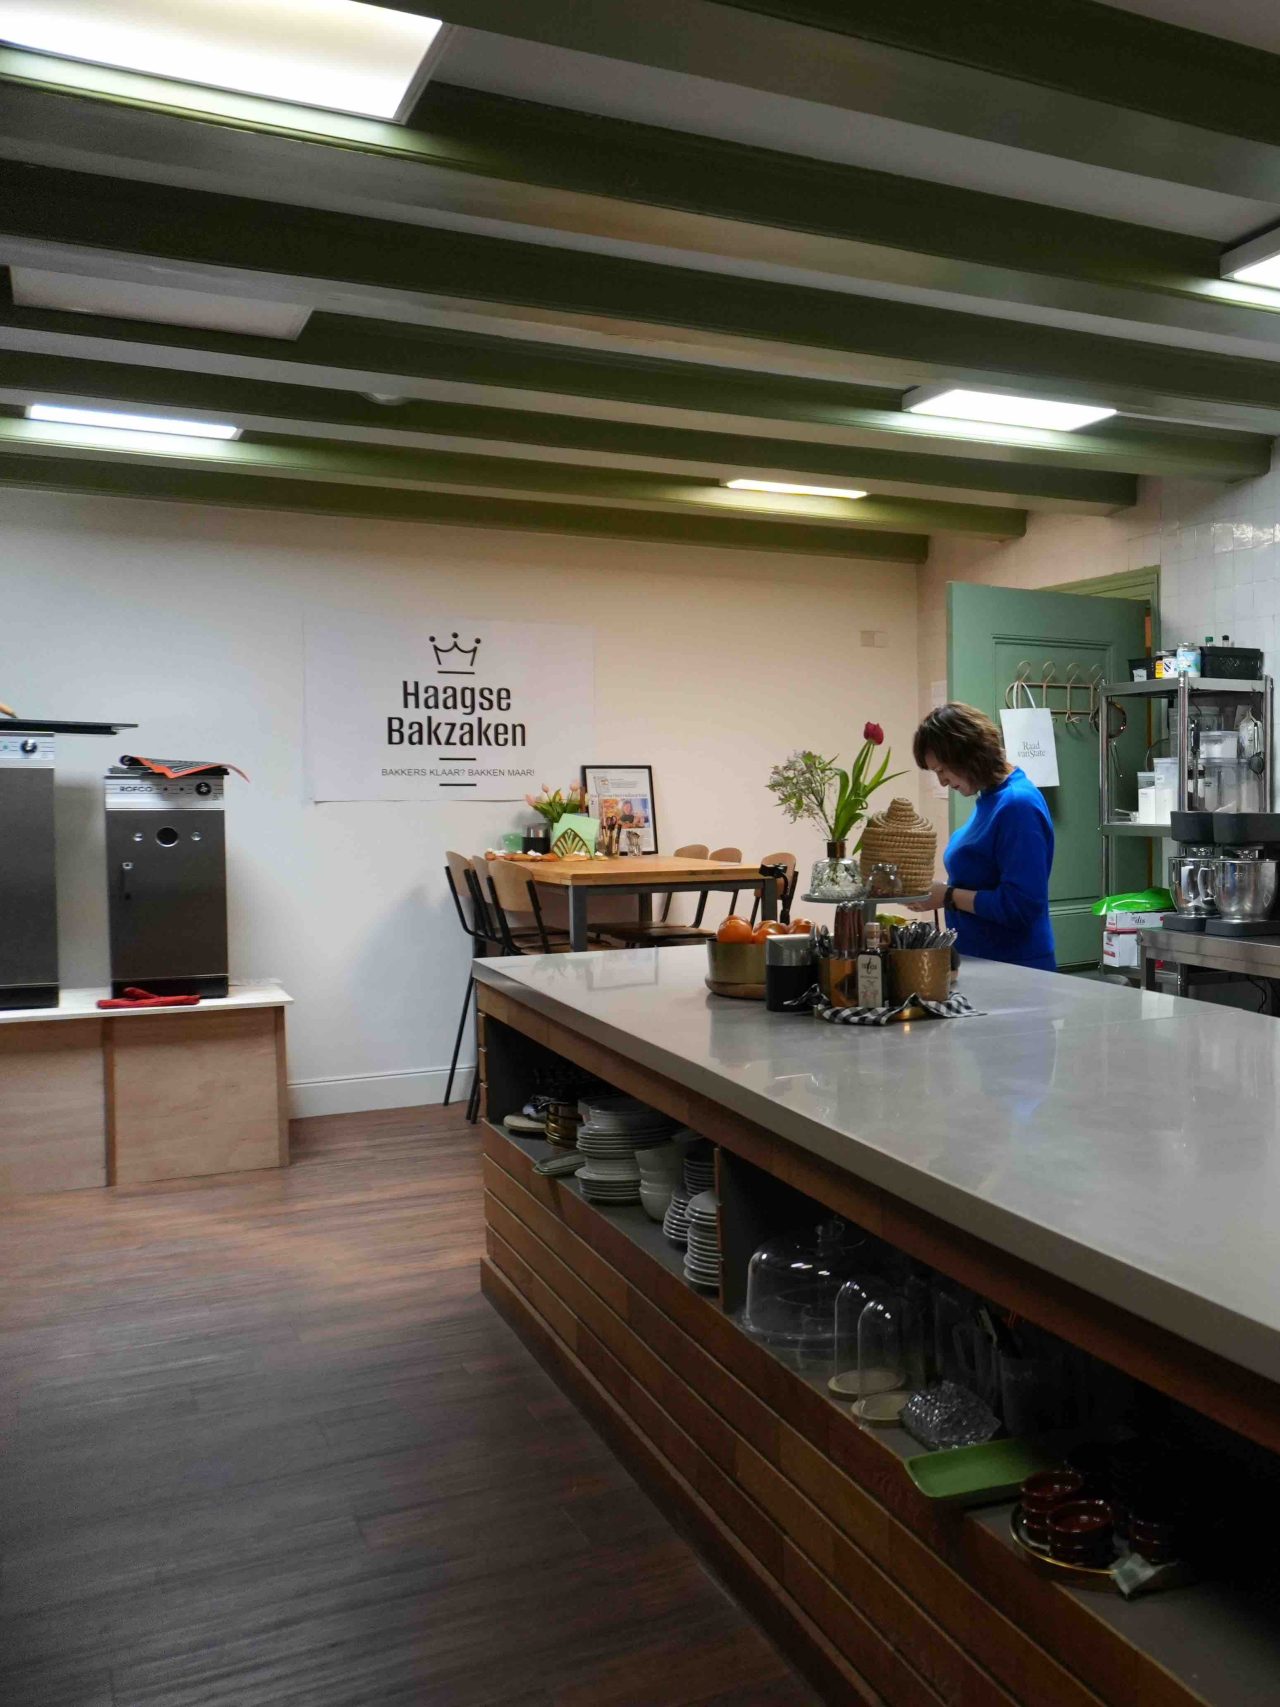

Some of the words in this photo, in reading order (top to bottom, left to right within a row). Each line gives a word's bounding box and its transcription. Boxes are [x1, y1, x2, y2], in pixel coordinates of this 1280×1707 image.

[402, 680, 511, 716] Haagse
[387, 715, 526, 747] Bakzaken
[381, 768, 427, 777] BAKKERS
[429, 768, 465, 777] KLAAR?
[468, 769, 505, 777] BAKKEN
[507, 769, 535, 777] MAAR!
